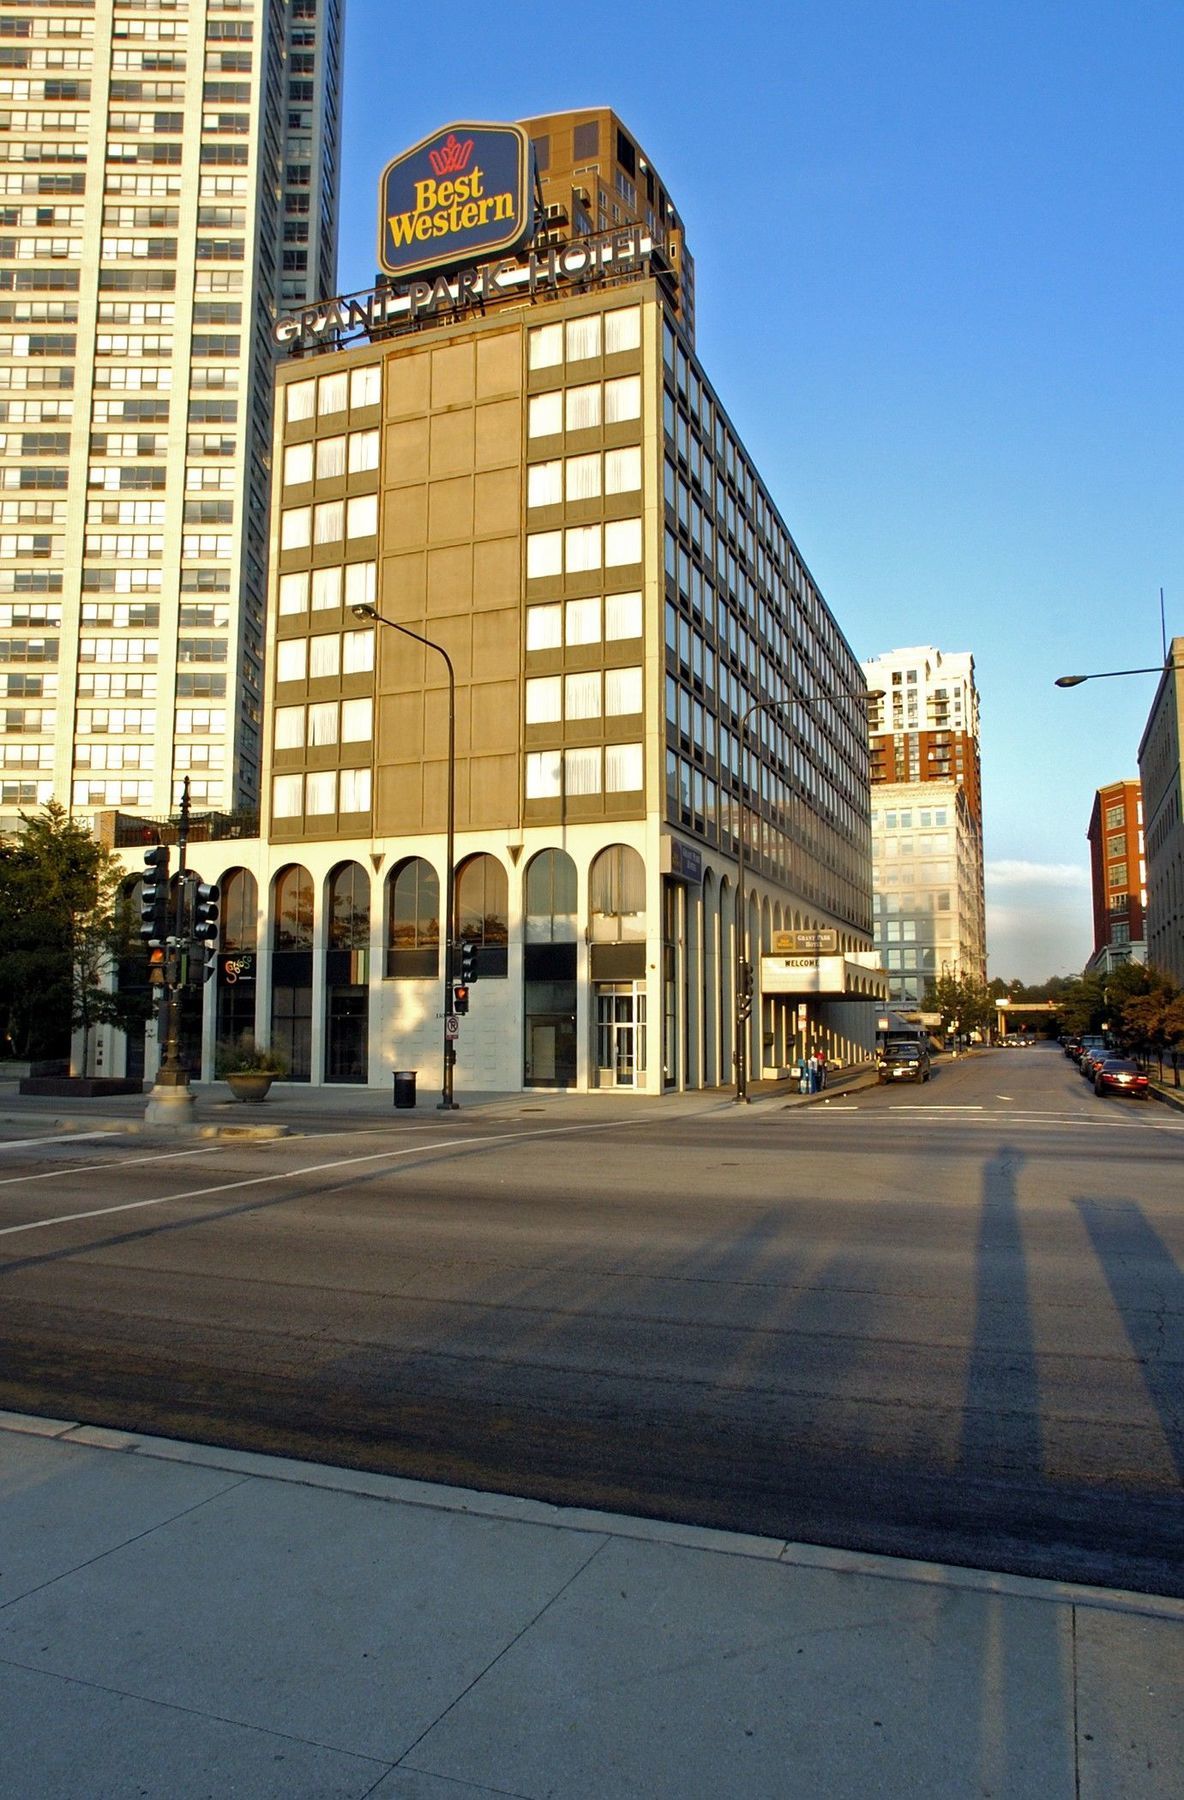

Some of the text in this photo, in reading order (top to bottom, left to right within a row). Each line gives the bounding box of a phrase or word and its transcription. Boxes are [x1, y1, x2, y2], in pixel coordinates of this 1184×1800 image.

[414, 166, 484, 214] Best
[387, 192, 516, 248] Western
[271, 228, 651, 348] GRANT PARK HOTEL
[785, 959, 819, 968] WELCOME
